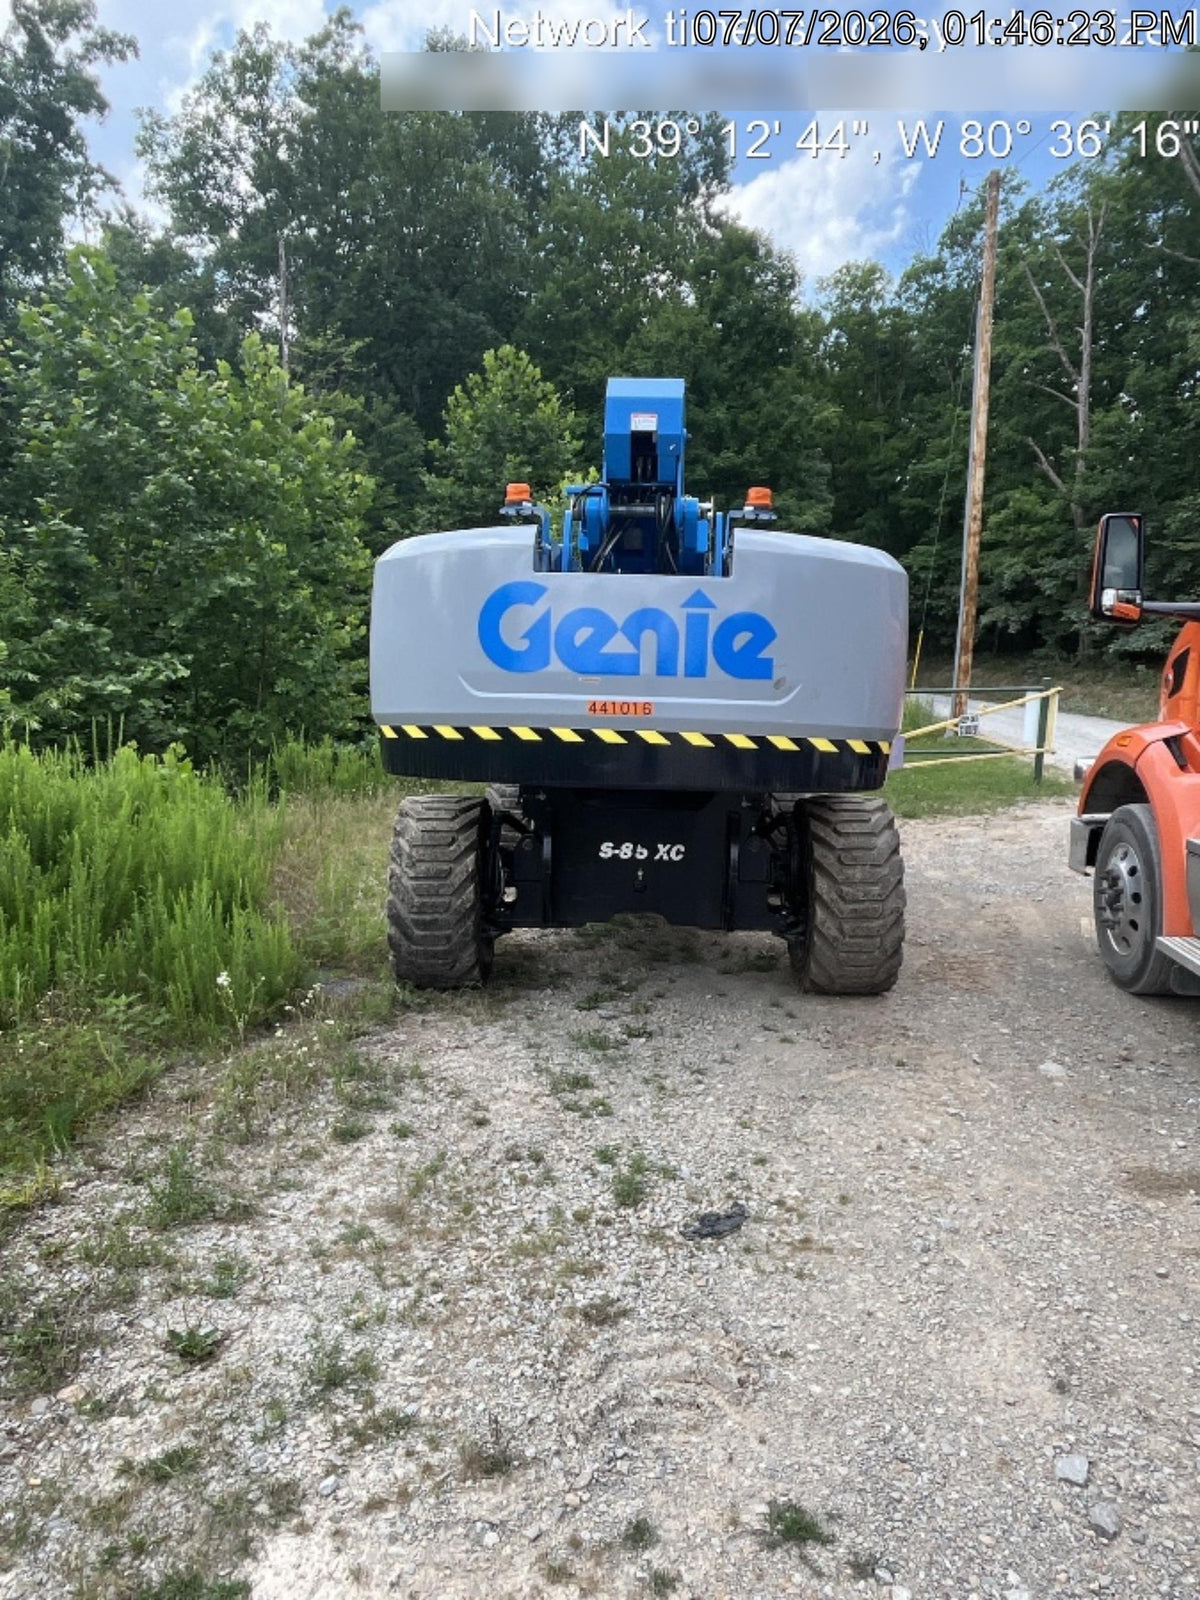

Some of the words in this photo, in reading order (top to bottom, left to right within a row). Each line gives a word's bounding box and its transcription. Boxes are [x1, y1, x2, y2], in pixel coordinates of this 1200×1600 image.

[477, 580, 778, 680] Genie
[588, 700, 653, 716] 441016
[653, 843, 686, 861] XC
